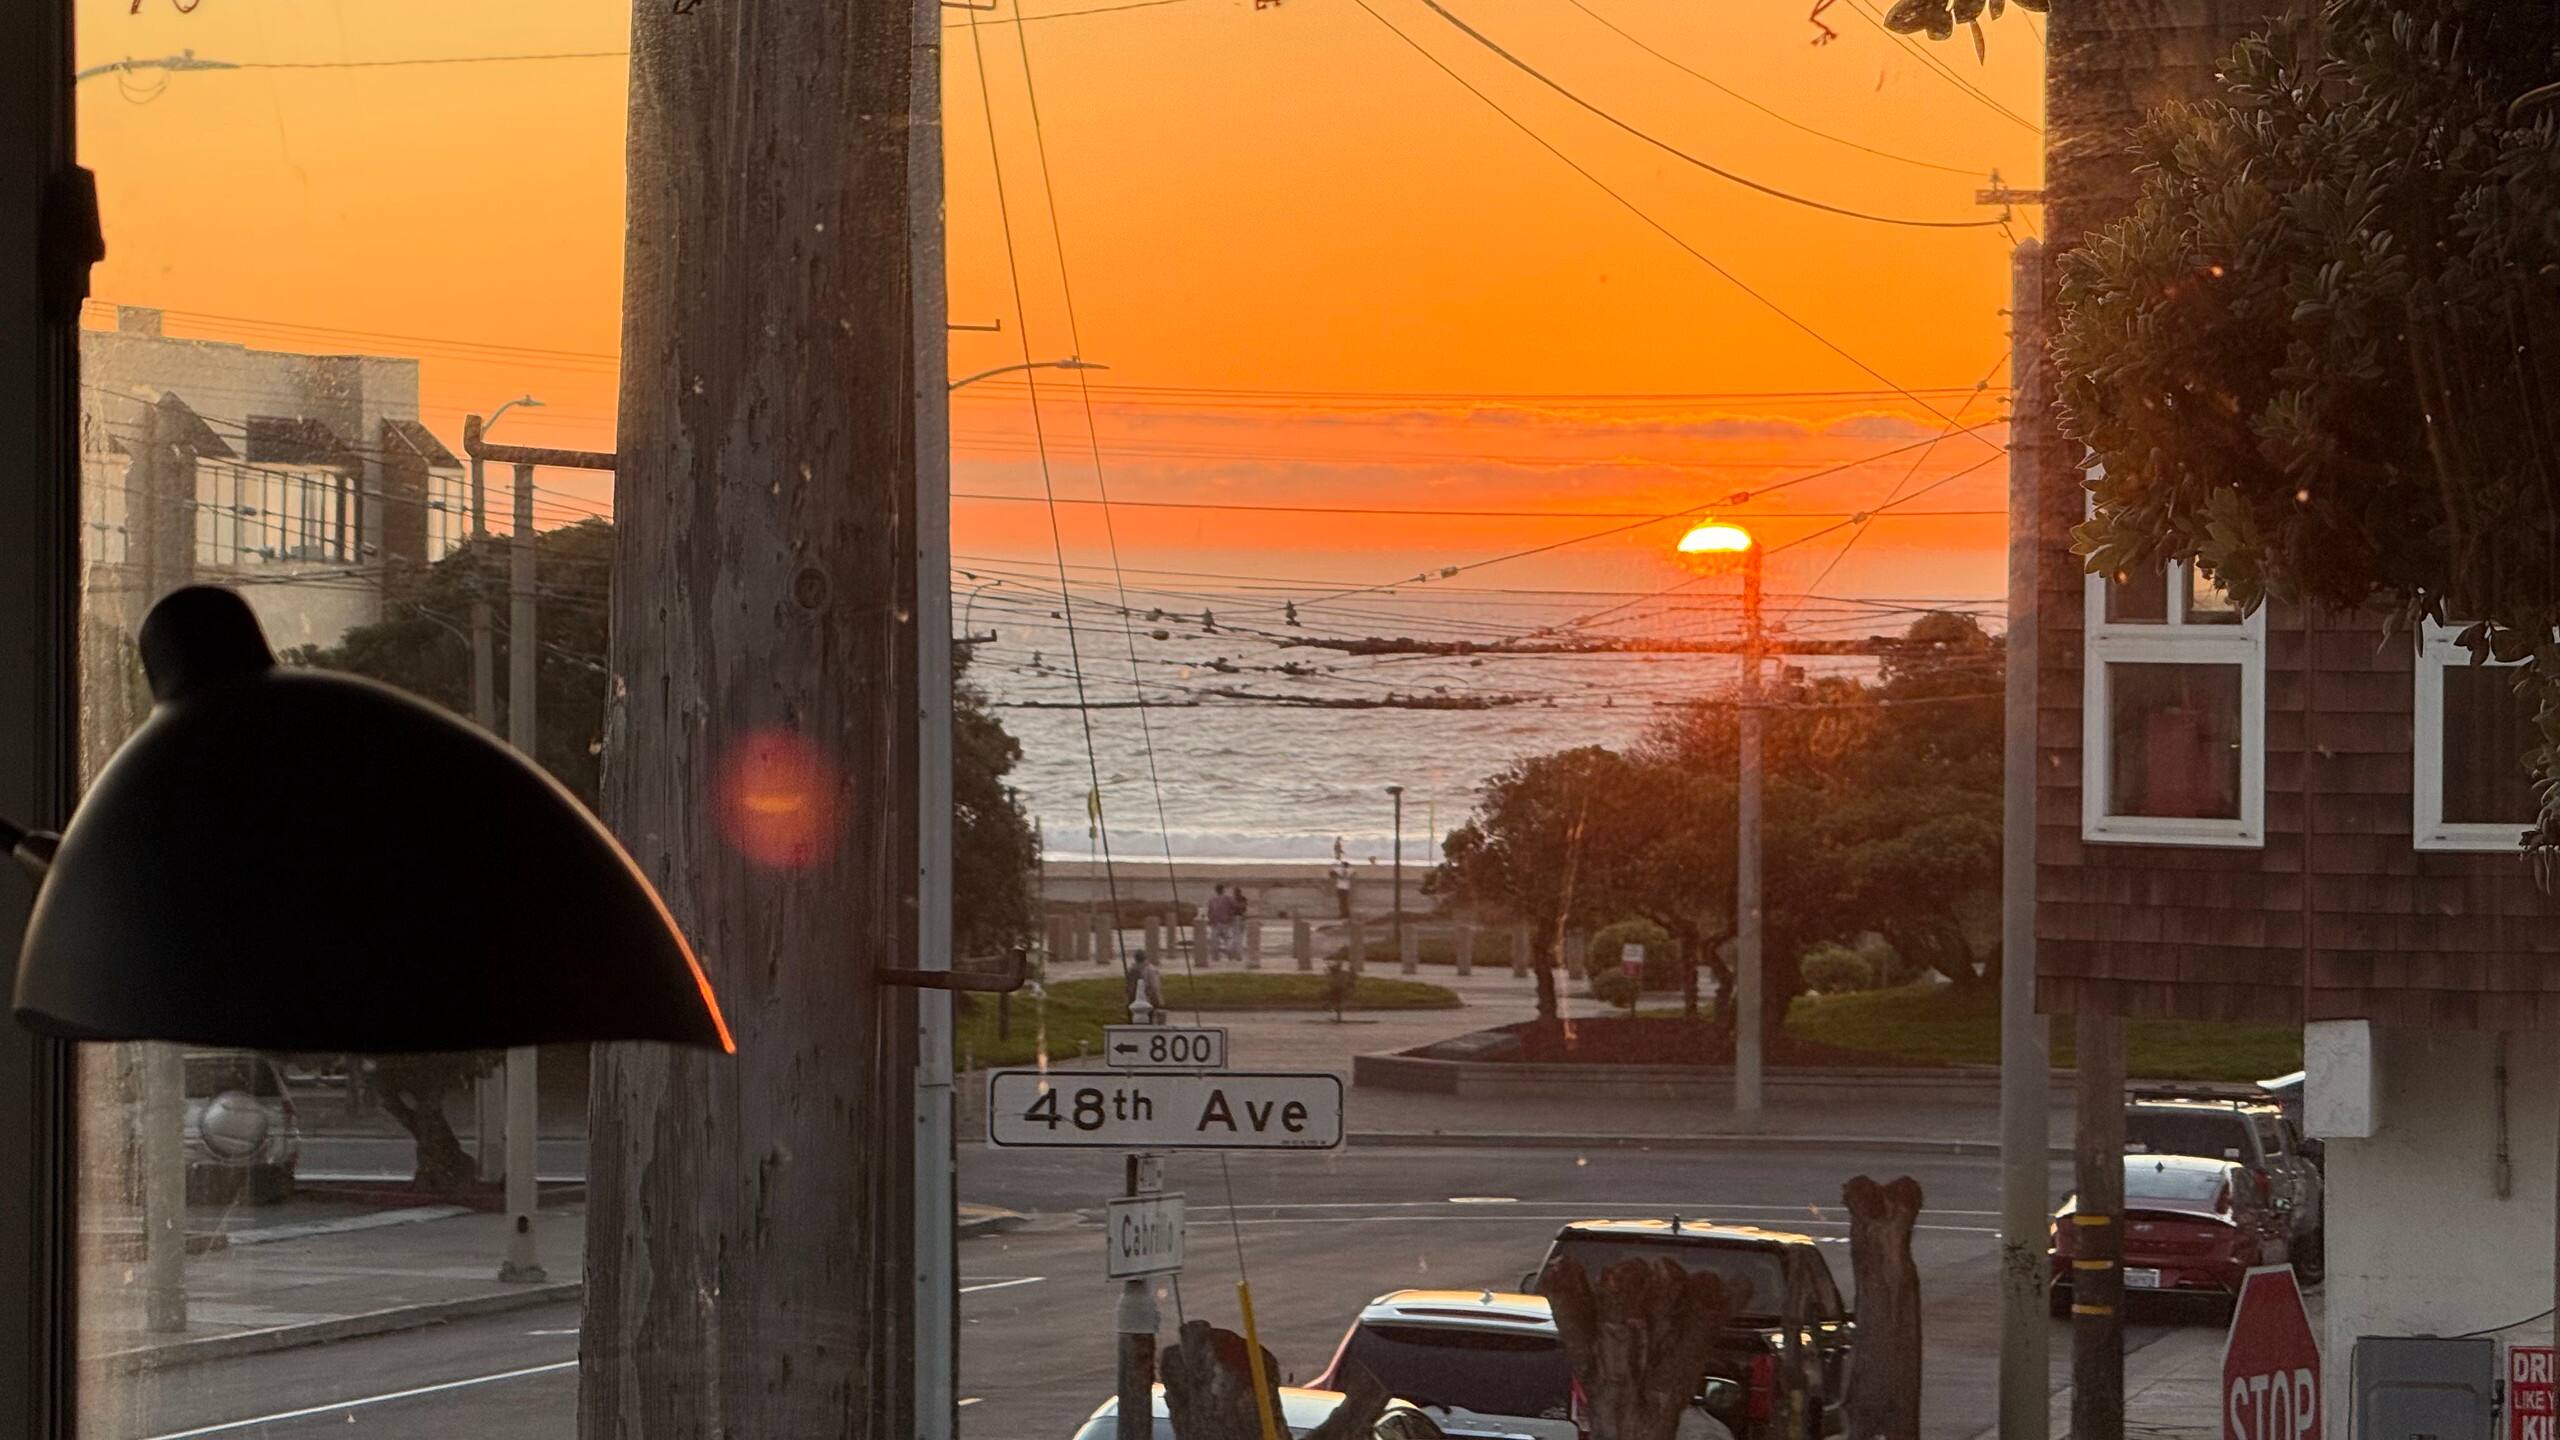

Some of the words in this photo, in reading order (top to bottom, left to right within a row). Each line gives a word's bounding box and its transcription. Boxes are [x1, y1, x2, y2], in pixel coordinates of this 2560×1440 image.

[1149, 1034, 1211, 1063] 800
[1023, 1087, 1153, 1131] 48th
[1196, 1088, 1308, 1133] Ave
[2230, 1367, 2315, 1440] STOP
[2514, 1391, 2545, 1410] LIKE
